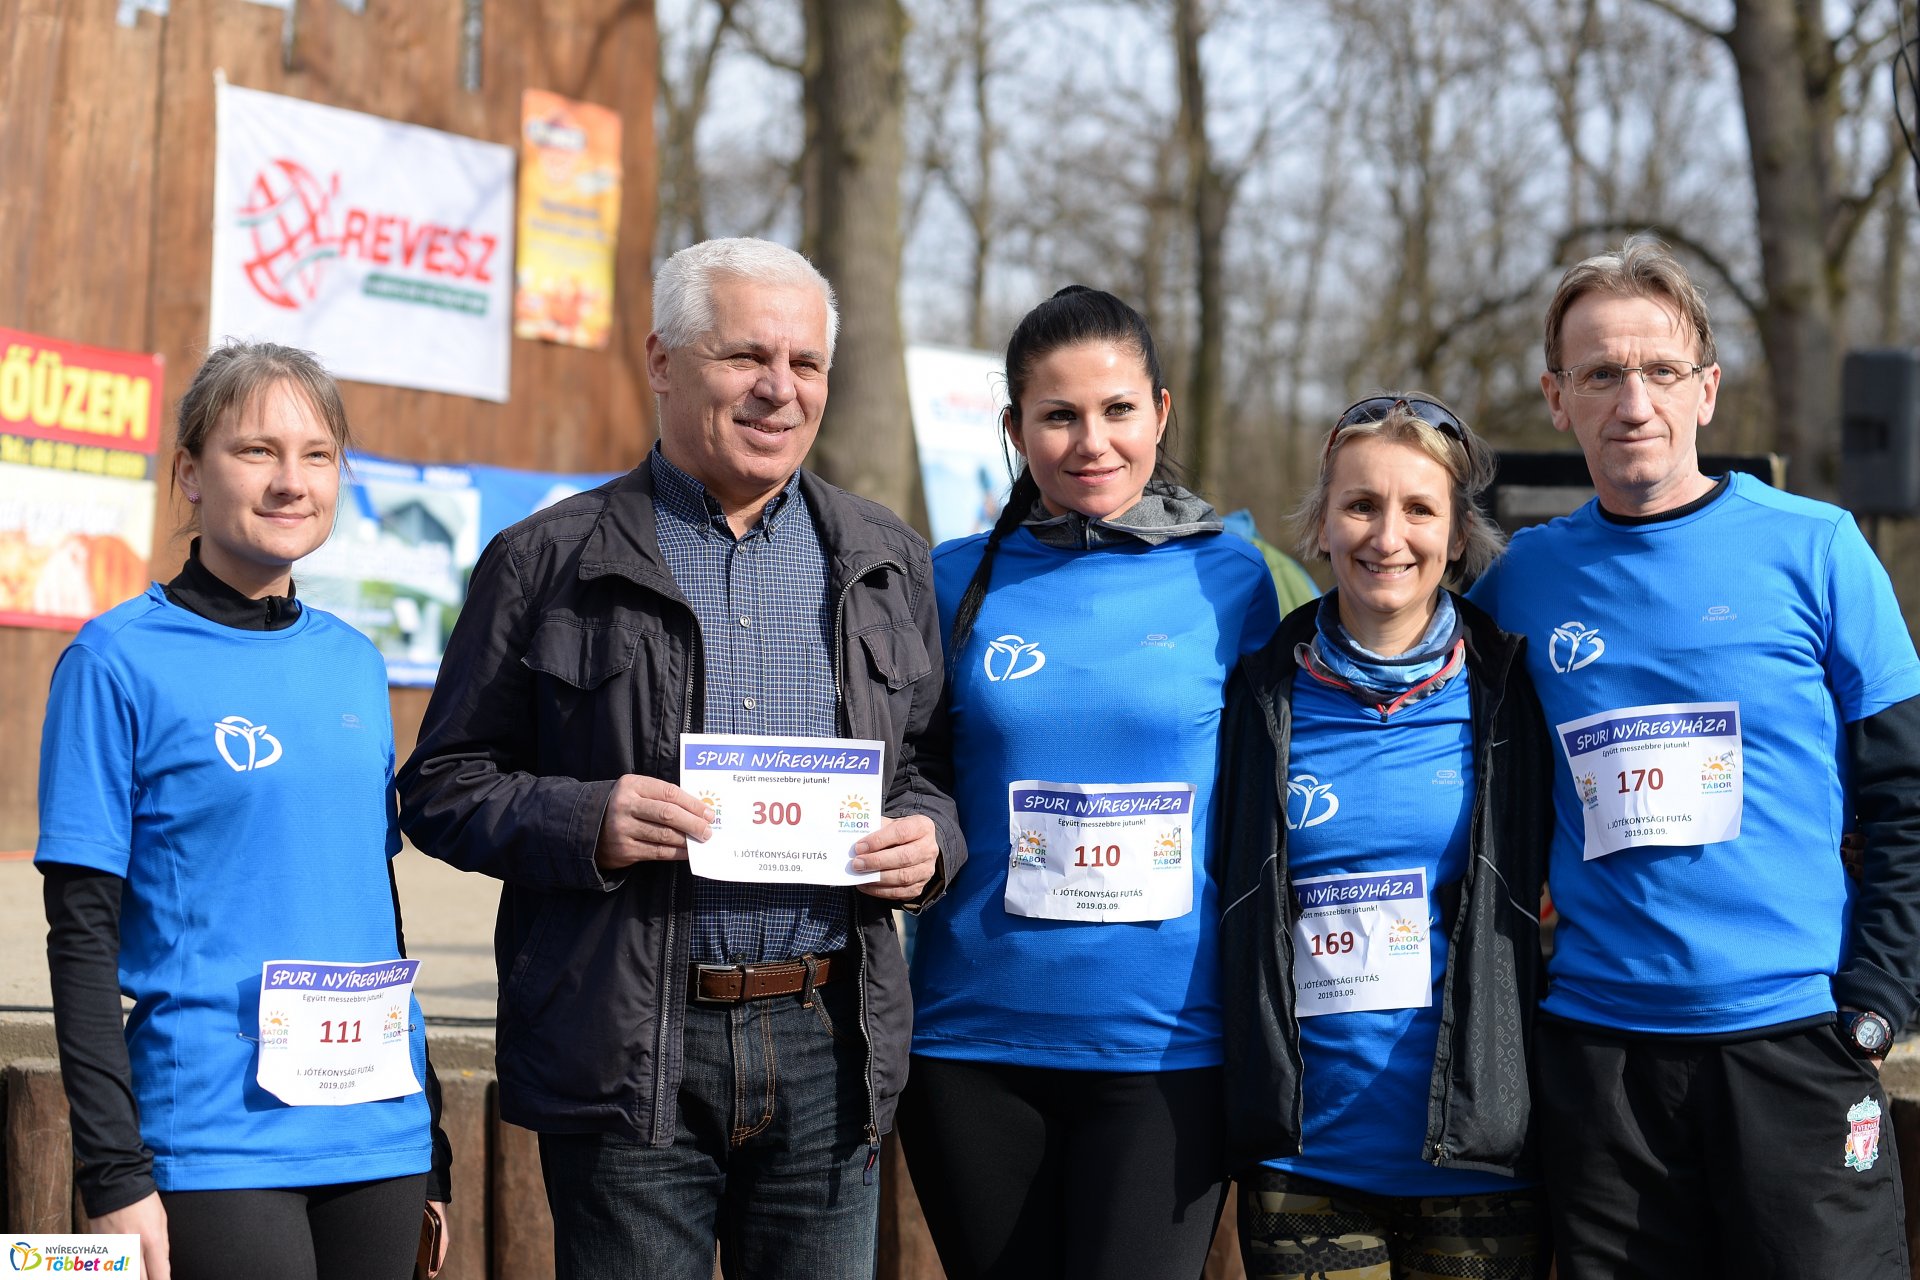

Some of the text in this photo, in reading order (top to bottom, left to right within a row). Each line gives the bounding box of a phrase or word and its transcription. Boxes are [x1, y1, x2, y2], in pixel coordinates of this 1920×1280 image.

[339, 209, 498, 284] REVESZ
[1577, 716, 1727, 751] SPURI NYÍREGYHÁZA
[1620, 743, 1661, 753] messzebbre
[1663, 741, 1690, 751] jutunk!
[696, 750, 870, 770] SPURI NYÍREGYHÁZA
[732, 774, 830, 785] Együtt messzebbre jutunk!
[1617, 768, 1664, 794] 170
[1701, 772, 1732, 781] BÁTOR
[1701, 781, 1732, 790] TÁBOR
[1024, 795, 1182, 816] SPURI NYÍREGYHÁZA
[752, 801, 802, 826] 300
[839, 810, 870, 820] BÁTOR
[838, 820, 870, 829] TÁBOR
[1058, 818, 1146, 828] Együtt messzebbre jutunk!
[1612, 815, 1665, 829] JÓTÉKONYSÁGI
[1666, 813, 1692, 823] FUTÁS
[1624, 828, 1668, 838] 2019.03.09.
[741, 849, 800, 859] JÓTÉKONYSÁGI
[802, 851, 828, 860] FUTÁS
[1074, 845, 1121, 867] 110
[1153, 857, 1180, 865] TÁBOR
[758, 864, 803, 872] 2019.03.09.
[1060, 888, 1118, 898] JÓTÉKONYSÁGI
[1120, 889, 1143, 898] FUTÁS
[1307, 880, 1414, 904] NYÍREGYHÁZA
[1076, 902, 1120, 910] 2019.03.09.
[1300, 905, 1378, 920] yütt messzebbre jutunk!
[1311, 931, 1354, 957] 169
[1389, 934, 1419, 943] BÁTOR
[1389, 943, 1419, 951] TÁBOR
[271, 966, 409, 988] SPURI NYÍREGYHÁZA
[1304, 976, 1353, 989] JÓTÉKONYSÁGI
[1355, 973, 1379, 983] FUTÁS
[302, 994, 326, 1003] Együtt
[328, 995, 366, 1003] messzebbre
[1318, 988, 1356, 1000] 2019.03.09.
[320, 1020, 362, 1043] 111
[304, 1067, 357, 1077] JÓTÉKONYSÁGI
[357, 1064, 374, 1074] FUTÁS
[319, 1081, 358, 1090] 2019.03.09.
